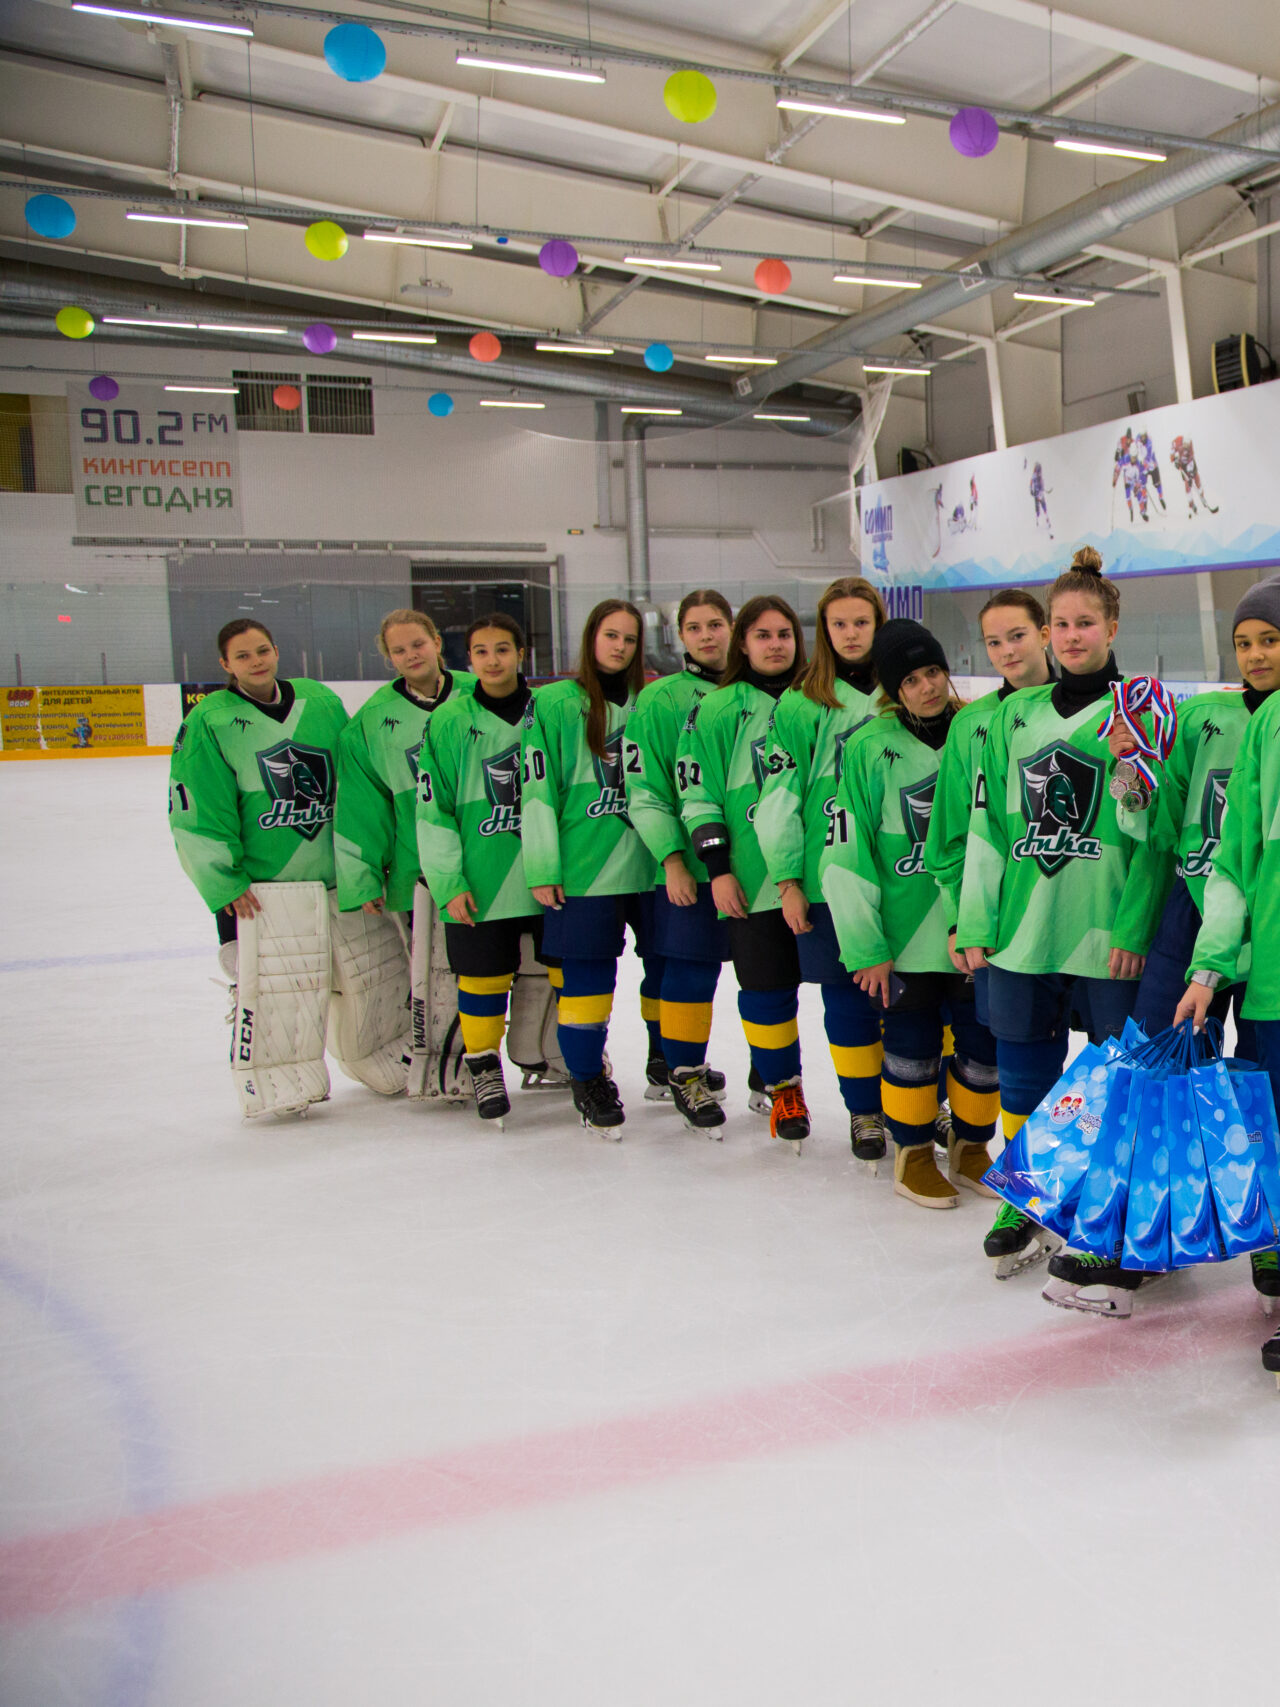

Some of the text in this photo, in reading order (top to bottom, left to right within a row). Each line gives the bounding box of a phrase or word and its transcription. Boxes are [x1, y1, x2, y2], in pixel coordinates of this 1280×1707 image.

[81, 408, 229, 446] 90.2 FM
[42, 695, 92, 706] ДЛЯ ДЕТЕЙ
[240, 1008, 254, 1061] CCM
[413, 996, 426, 1048] VAUGHN
